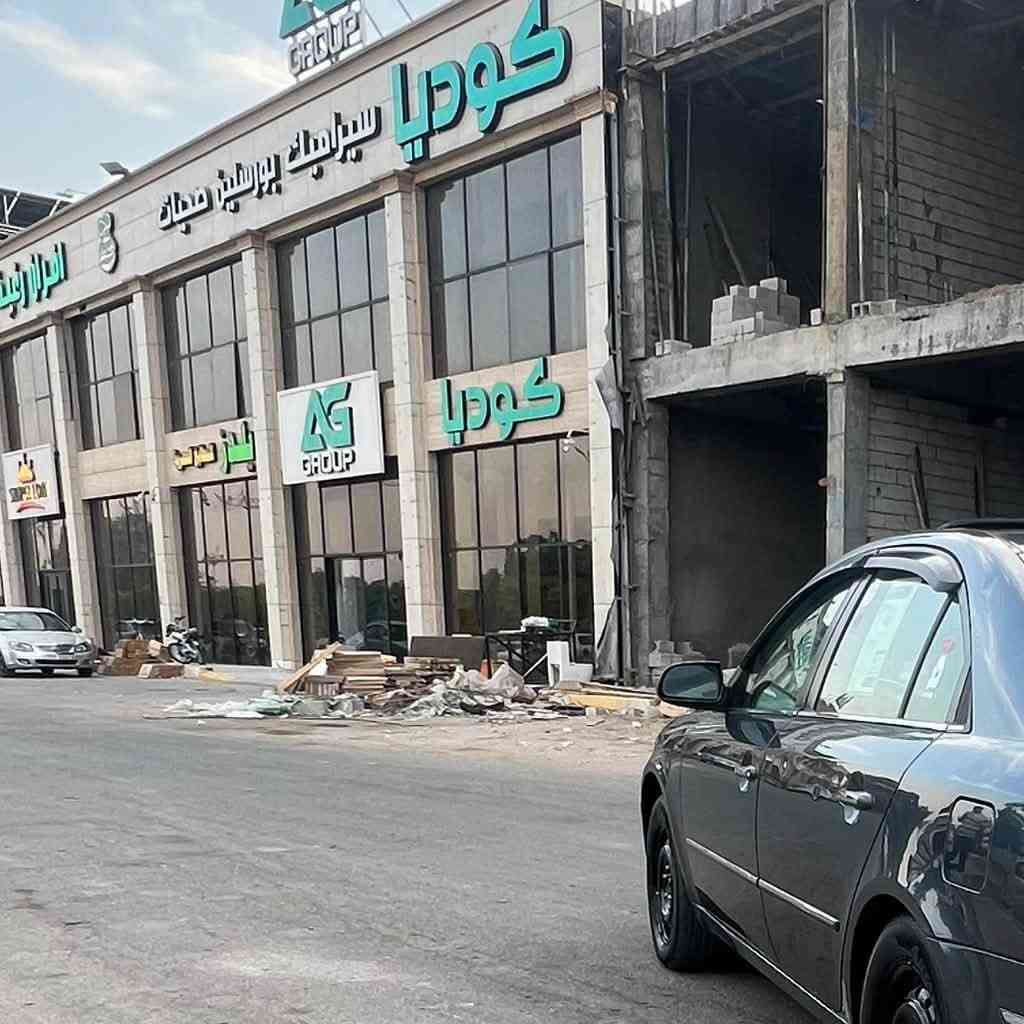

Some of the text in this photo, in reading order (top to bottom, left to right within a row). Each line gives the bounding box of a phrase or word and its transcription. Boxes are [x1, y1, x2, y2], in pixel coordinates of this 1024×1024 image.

[288, 10, 360, 76] GROUP
[391, 0, 573, 163] كوديا
[286, 105, 382, 179] سيراميك
[301, 381, 355, 453] AG
[440, 355, 565, 446] كوديا
[301, 448, 357, 477] GROUP
